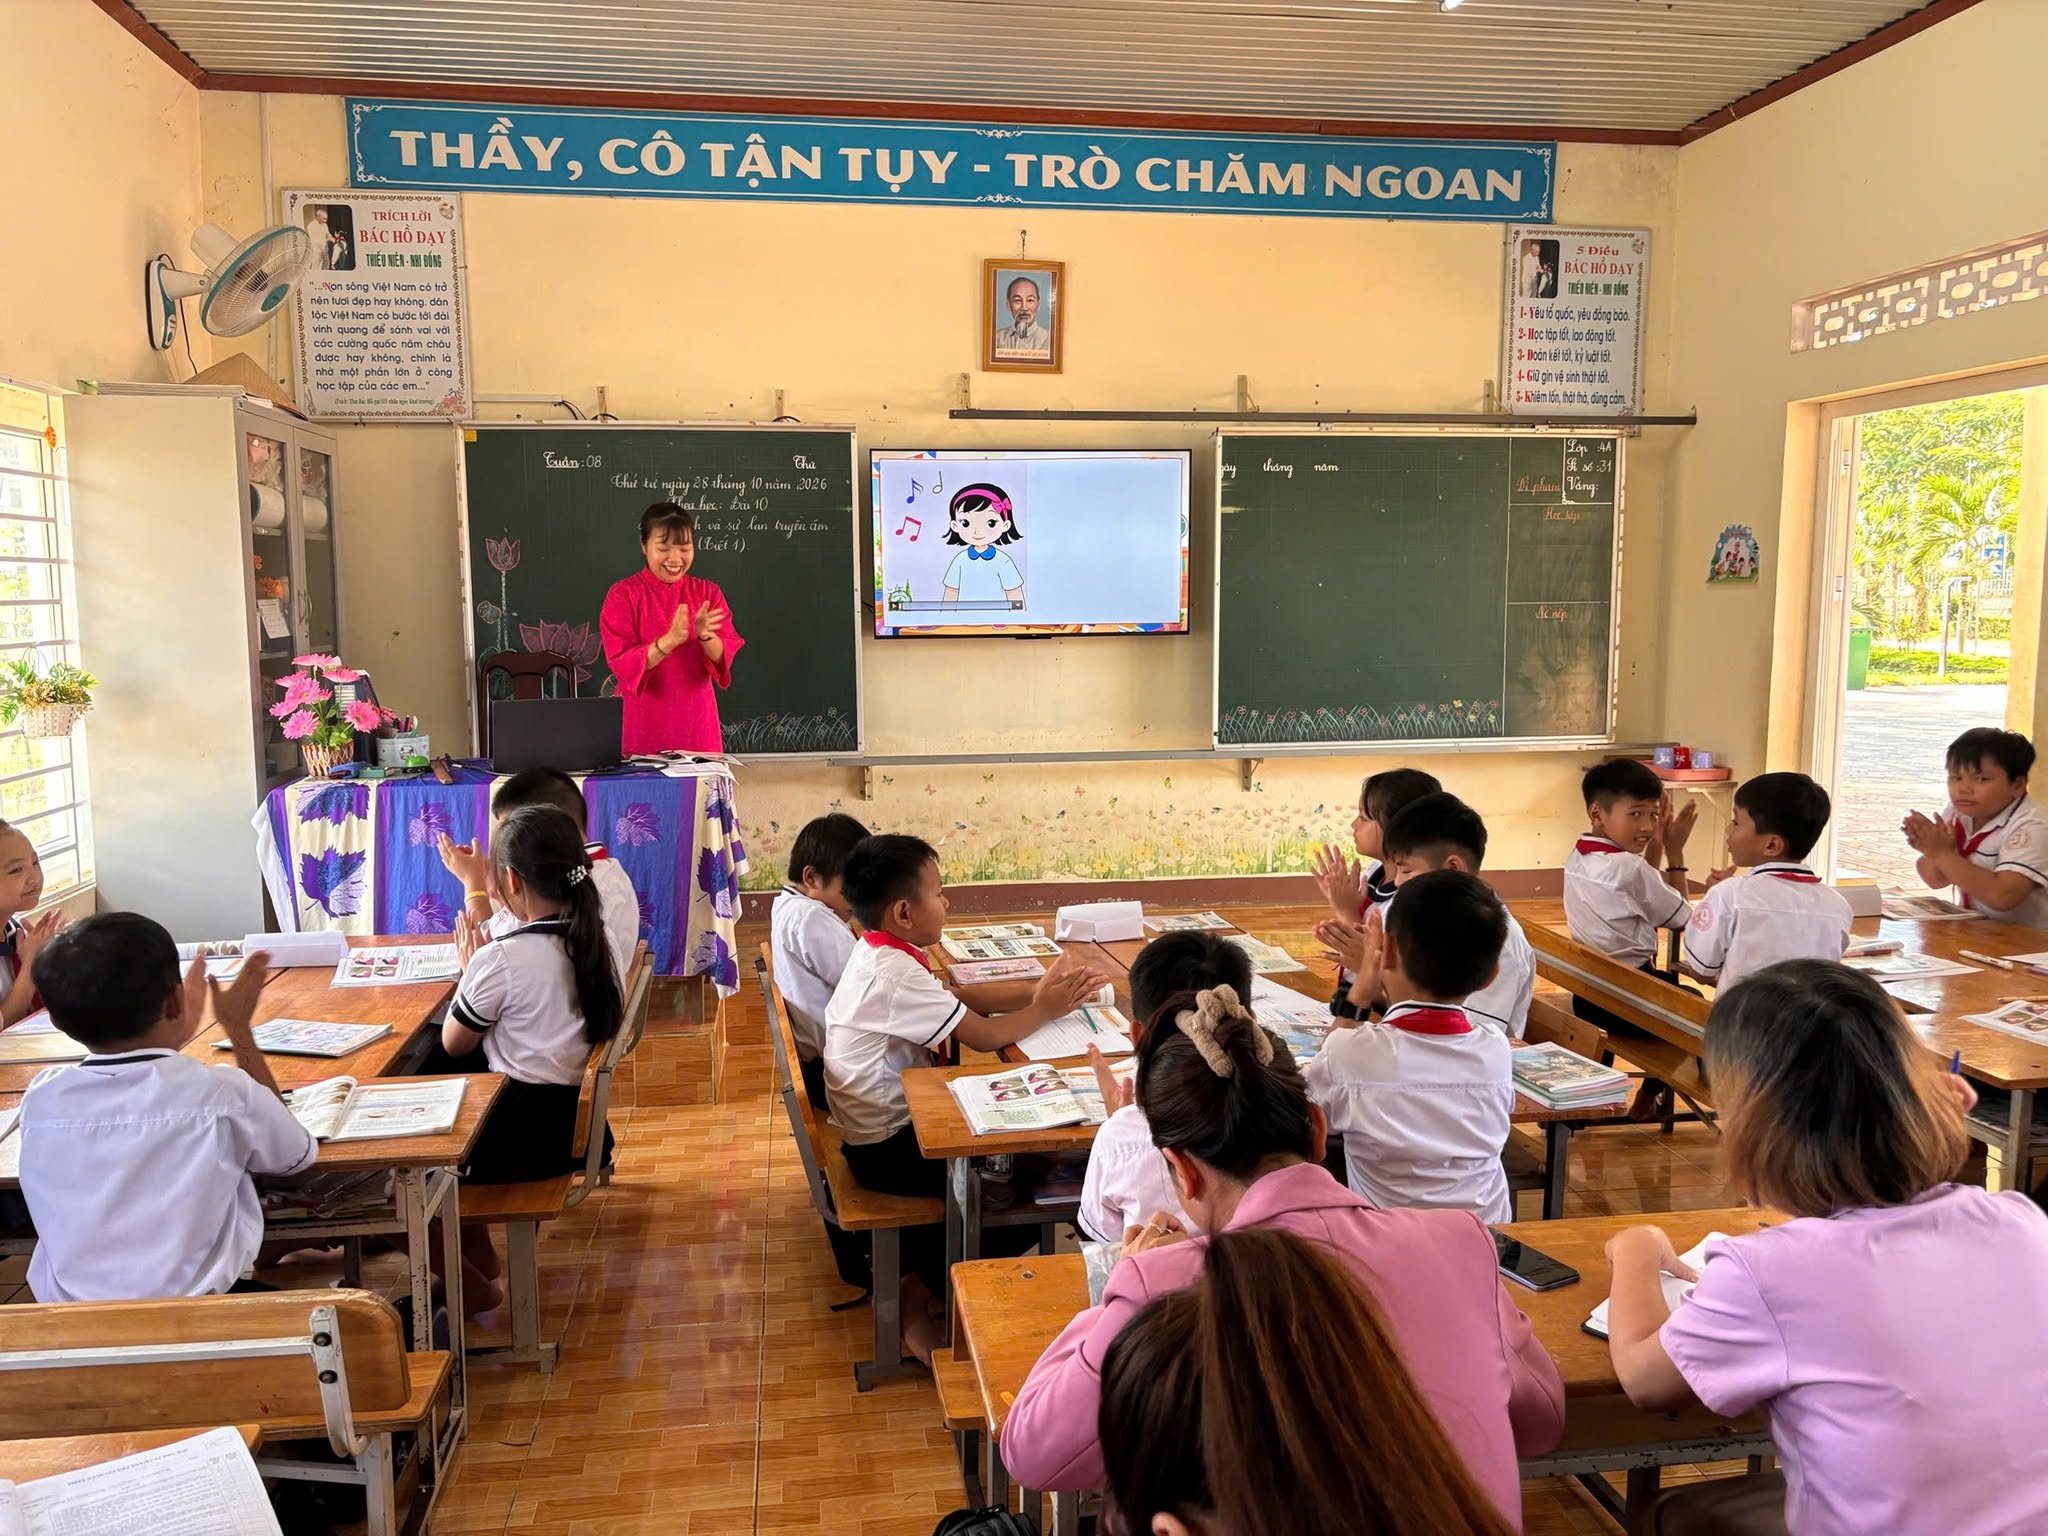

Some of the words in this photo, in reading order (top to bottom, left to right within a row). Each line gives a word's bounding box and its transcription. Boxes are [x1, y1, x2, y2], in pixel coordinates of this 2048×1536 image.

[389, 117, 583, 182] THẦY,
[599, 130, 686, 176] CÔ
[701, 133, 821, 188] TẬN
[839, 147, 958, 193] TỤY
[973, 165, 990, 173] -
[1005, 146, 1121, 191] TRÒ
[1135, 152, 1308, 196] CHĂM
[1324, 164, 1522, 202] NGOAN
[371, 210, 408, 222] TRÍCH
[412, 210, 431, 222] LỜI
[359, 227, 389, 243] BÁC
[393, 224, 413, 243] HỒ
[416, 230, 446, 247] DẠY
[1576, 246, 1584, 255] 5
[1588, 244, 1619, 256] Điều
[366, 250, 386, 267] THIẾU
[388, 252, 405, 268] NIÊN
[410, 254, 422, 268] NHI
[1564, 259, 1588, 274] BÁC
[1590, 257, 1607, 274] HỒ
[1609, 263, 1634, 277] DẠY
[346, 282, 369, 293] sông
[372, 282, 391, 292] Việt
[393, 283, 416, 292] Nam
[419, 282, 431, 292] có
[311, 297, 329, 305] nên
[352, 297, 371, 307] đẹp
[374, 297, 392, 307] hay
[430, 297, 449, 306] dân
[312, 311, 327, 321] tộc
[330, 311, 349, 321] Việt
[352, 311, 374, 320] Nam
[377, 310, 389, 320] có
[392, 311, 416, 320] bước
[419, 311, 431, 320] tới
[433, 311, 449, 320] đài
[1529, 306, 1544, 319] Yêu
[1546, 303, 1554, 320] tổ
[1555, 305, 1575, 323] quốc,
[1578, 307, 1591, 323] yêu
[1593, 306, 1612, 324] đồng
[1613, 307, 1630, 321] bào.
[313, 325, 332, 333] vinh
[337, 325, 368, 336] quang
[372, 323, 385, 334] để
[390, 325, 412, 335] sánh
[417, 325, 431, 334] vai
[436, 325, 450, 334] với
[1527, 328, 1544, 343] Học
[1545, 328, 1558, 344] tập
[1559, 327, 1571, 342] tốt,
[1572, 329, 1584, 341] lao
[1585, 329, 1604, 345] động
[1605, 328, 1617, 342] tốt.
[314, 339, 333, 348] các
[338, 340, 368, 350] cường
[372, 338, 397, 350] quốc
[401, 339, 422, 348] năm
[427, 340, 451, 349] châu
[314, 354, 340, 364] được
[347, 354, 364, 364] hay
[410, 354, 436, 362] chính
[442, 354, 451, 362] là
[1548, 347, 1561, 361] kết
[1562, 348, 1573, 364] tốt,
[1575, 347, 1584, 365] kỷ
[1585, 349, 1599, 365] luật
[1600, 348, 1612, 363] tốt.
[316, 368, 334, 377] nhờ
[340, 368, 359, 378] một
[364, 366, 389, 378] phần
[395, 368, 410, 377] lớn
[415, 367, 422, 377] ở
[428, 368, 453, 379] công
[1527, 369, 1540, 382] Giữ
[1541, 370, 1553, 385] gìn
[1554, 371, 1564, 385] vệ
[1566, 371, 1580, 382] sinh
[1582, 371, 1596, 386] thật
[1598, 370, 1610, 383] tốt.
[316, 382, 335, 392] học
[338, 382, 355, 392] tập
[358, 381, 377, 391] của
[380, 382, 399, 391] các
[1263, 458, 1294, 478] tháng
